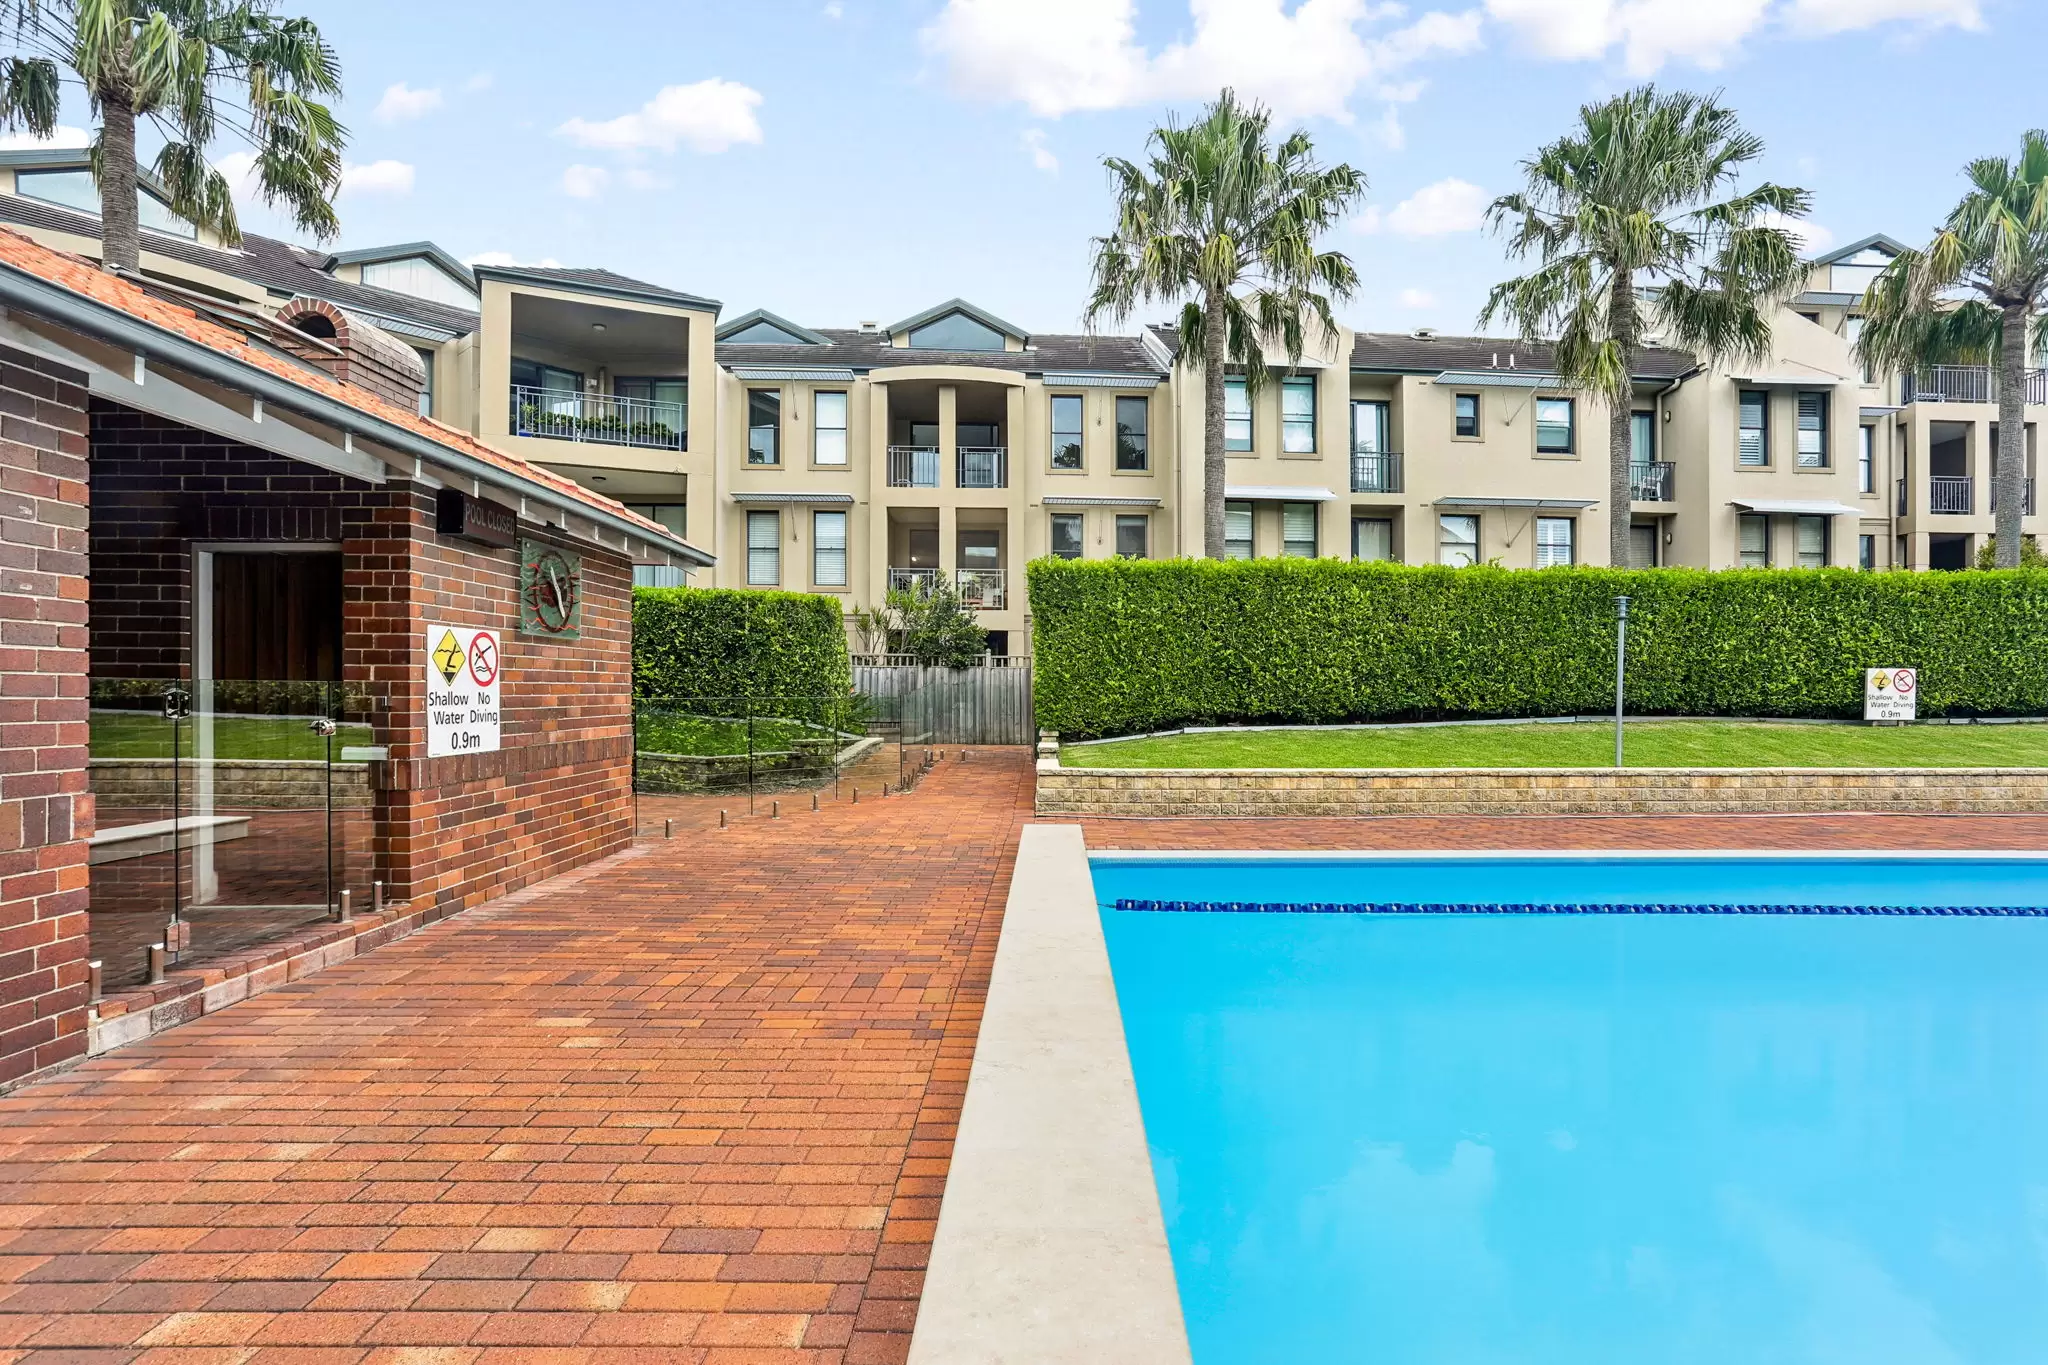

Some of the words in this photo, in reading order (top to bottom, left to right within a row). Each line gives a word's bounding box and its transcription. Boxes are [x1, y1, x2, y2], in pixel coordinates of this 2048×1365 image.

[465, 503, 486, 526] POOL
[487, 511, 515, 535] CLOSED
[429, 691, 469, 706] Shallow
[478, 692, 491, 704] No
[1893, 701, 1914, 709] Diving
[433, 711, 464, 725] Water
[470, 708, 498, 725] Diving
[1880, 710, 1901, 718] 0.9m
[451, 731, 480, 750] 0.9m
